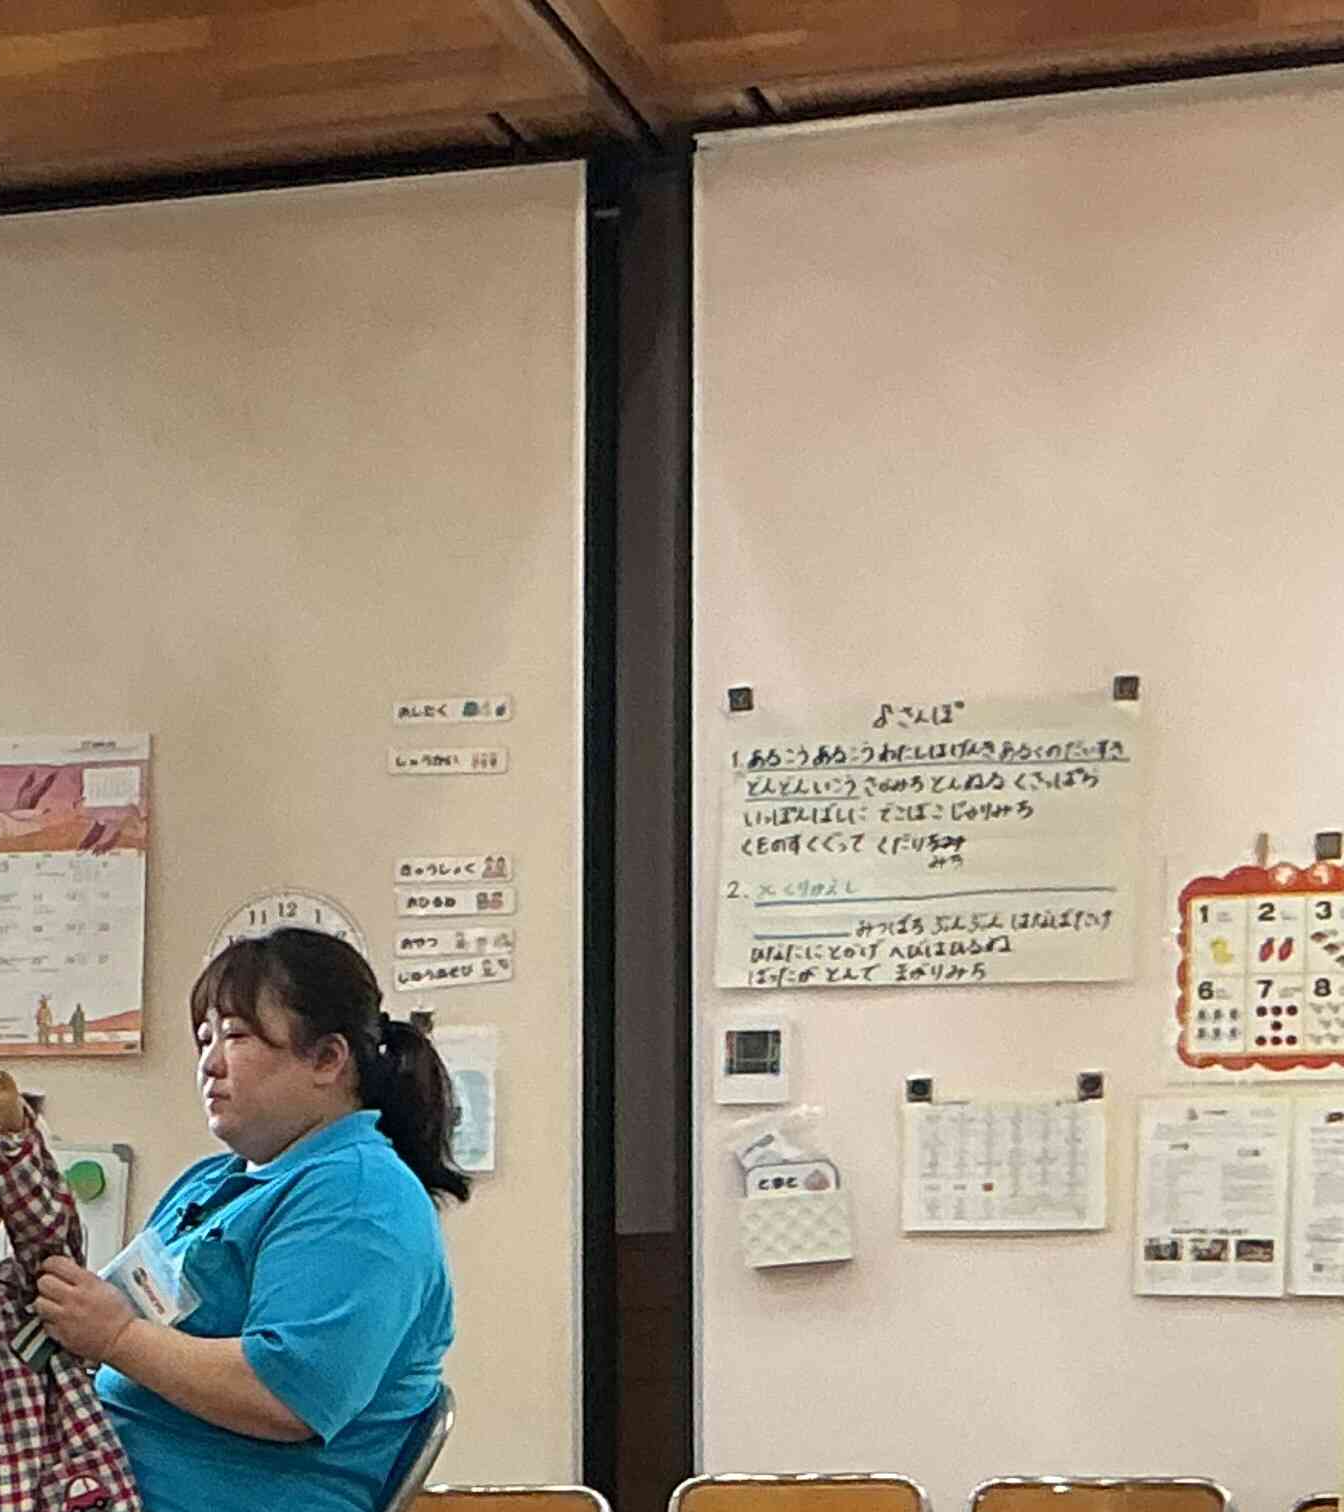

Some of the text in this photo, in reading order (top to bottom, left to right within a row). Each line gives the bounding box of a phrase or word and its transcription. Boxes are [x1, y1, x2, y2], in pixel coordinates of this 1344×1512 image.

[249, 909, 268, 925] 11
[277, 901, 298, 918] 12
[314, 908, 321, 924] 1
[1199, 904, 1209, 924] 1
[1257, 902, 1277, 922] 2
[1314, 900, 1333, 920] 3
[1197, 980, 1214, 1000] 6
[1256, 979, 1274, 999] 7
[1313, 977, 1332, 998] 8
